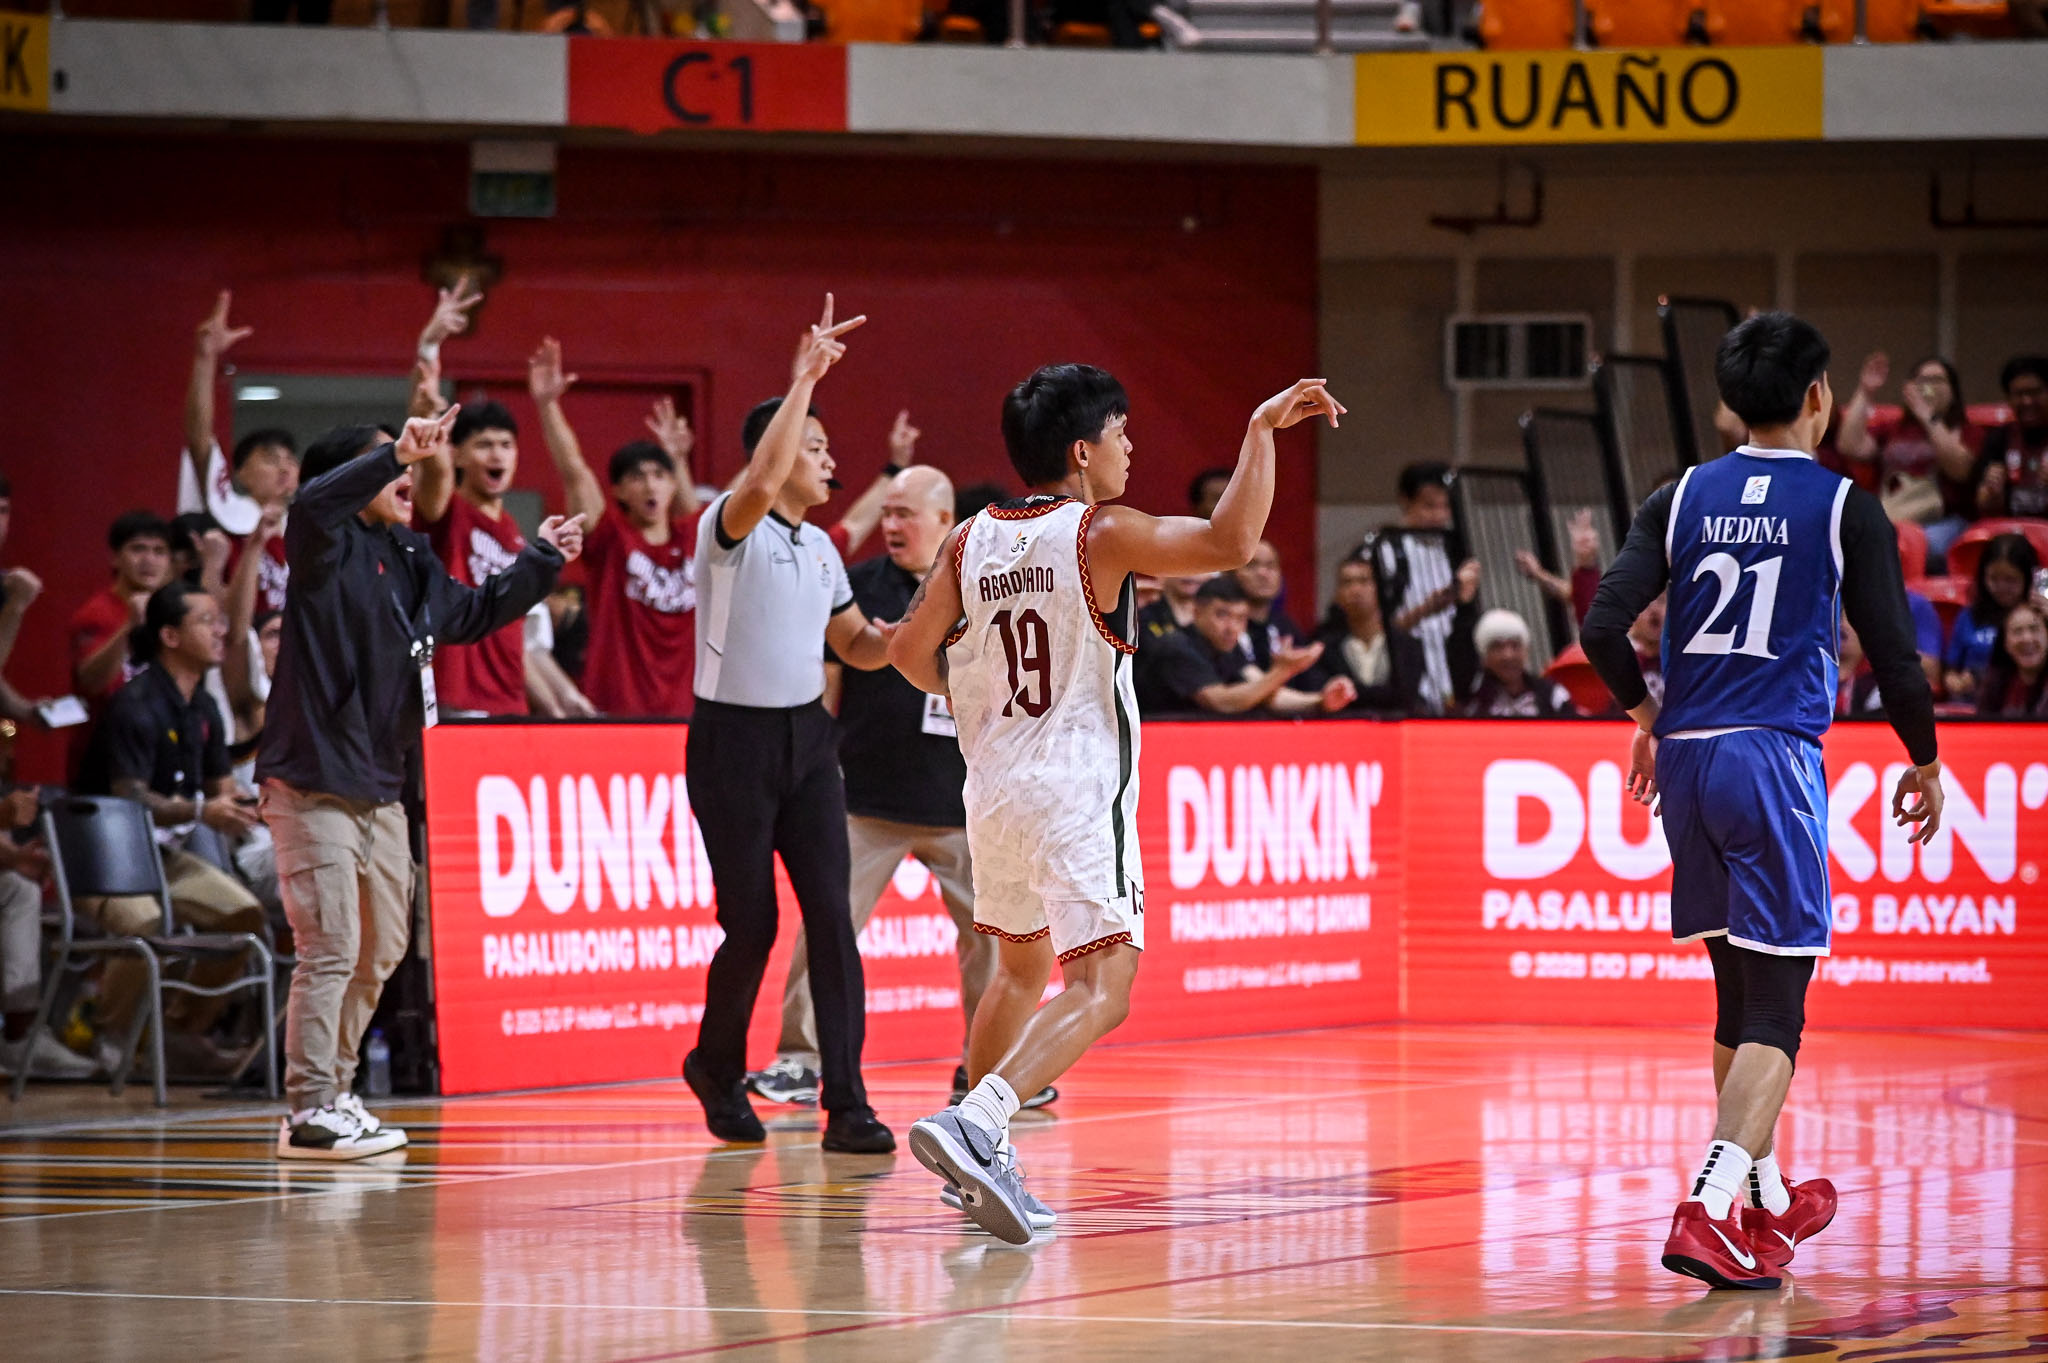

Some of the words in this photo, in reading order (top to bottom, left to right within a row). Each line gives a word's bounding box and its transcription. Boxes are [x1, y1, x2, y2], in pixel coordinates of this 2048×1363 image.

[664, 51, 752, 124] C1
[1435, 55, 1739, 130] RUAÑO
[1701, 516, 1789, 545] MEDINA
[979, 566, 1054, 602] ABADIANO
[1682, 552, 1784, 660] 21
[991, 609, 1052, 718] 19
[1168, 760, 1383, 889] DUNKIN'
[1483, 759, 2048, 884] DUKIN'
[1482, 889, 1673, 932] PASALUB
[1831, 893, 1860, 933] G
[1872, 893, 2017, 935] BAYAN
[483, 928, 636, 979] PASALUBONG
[637, 925, 674, 970] NG
